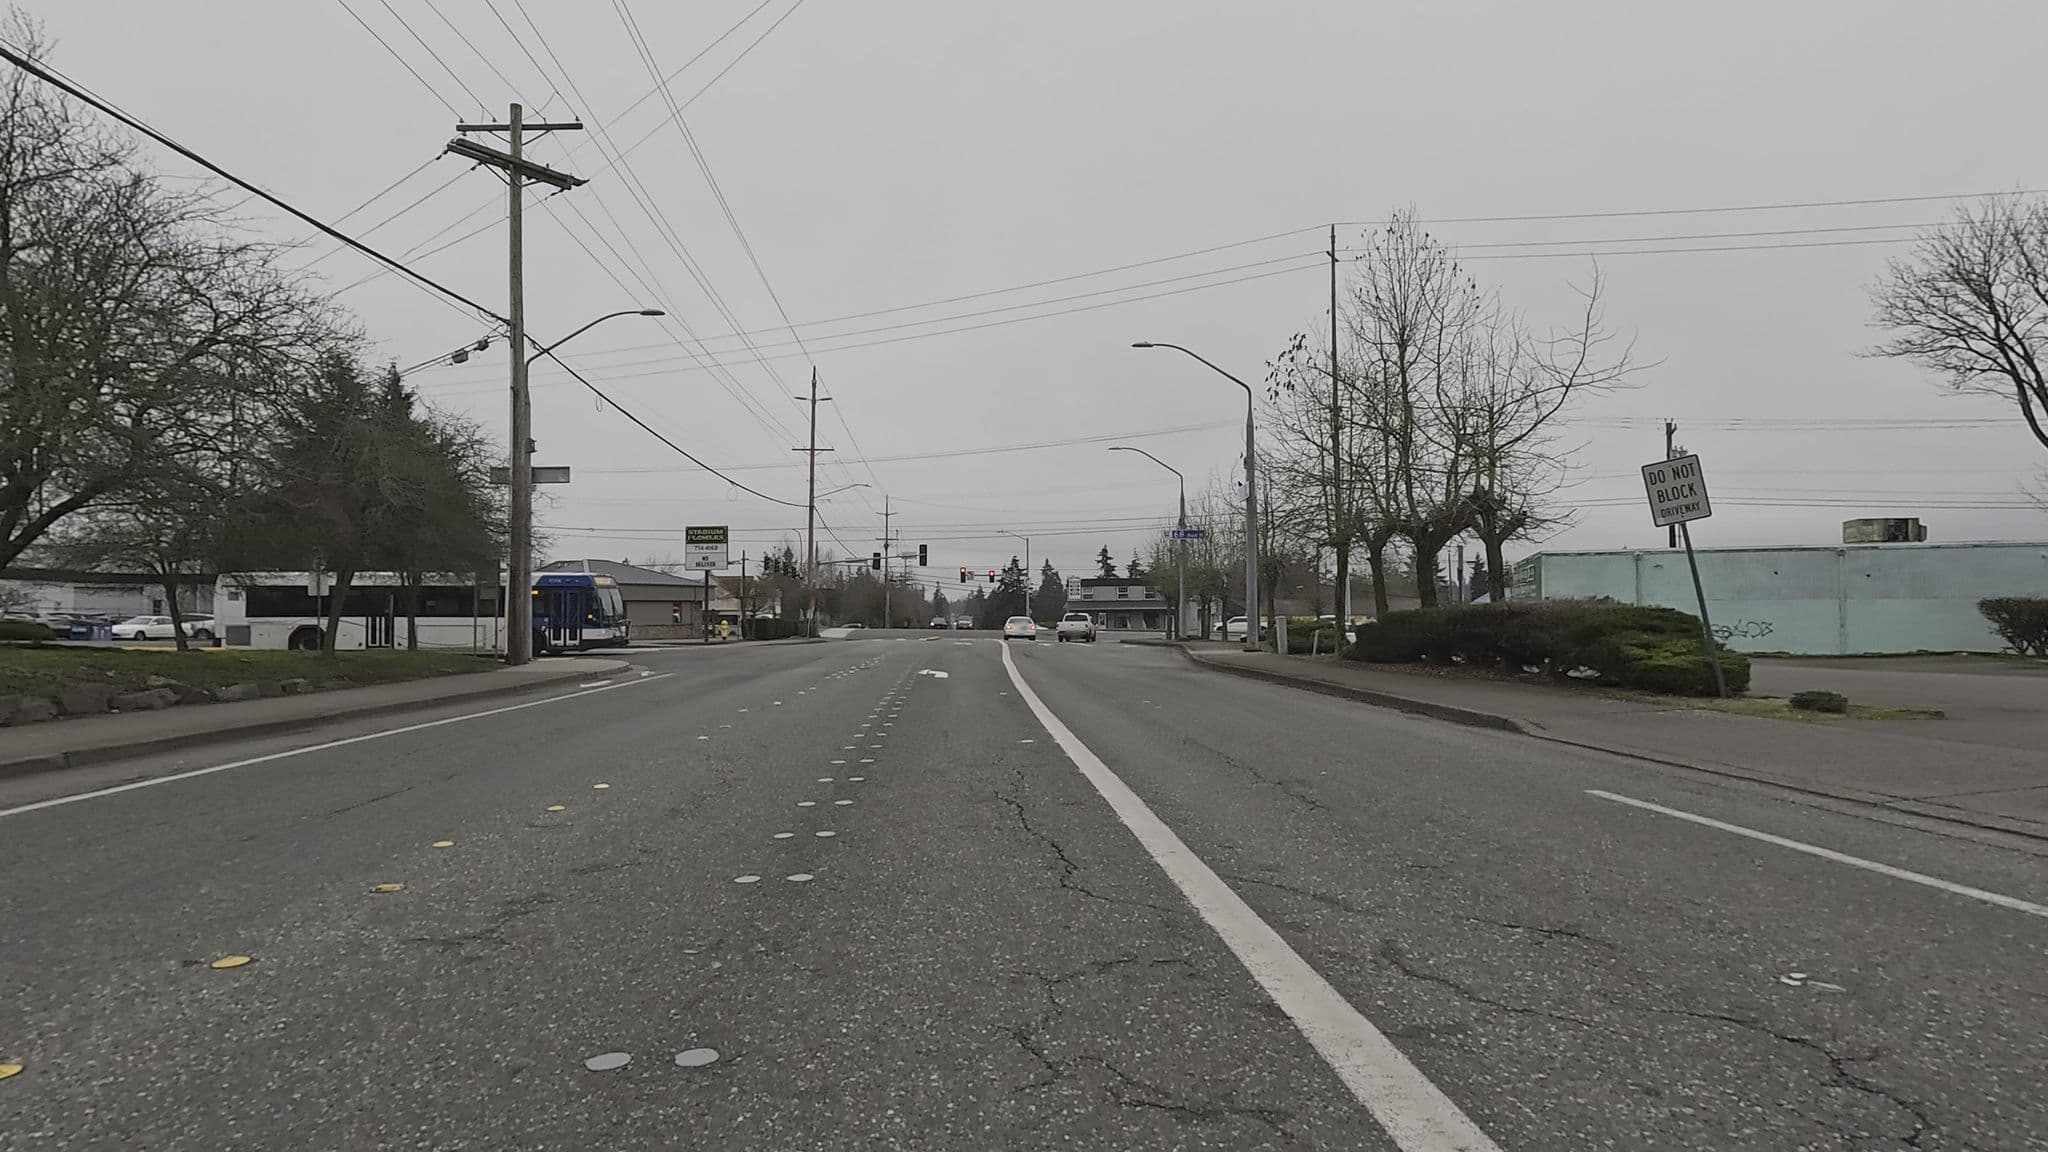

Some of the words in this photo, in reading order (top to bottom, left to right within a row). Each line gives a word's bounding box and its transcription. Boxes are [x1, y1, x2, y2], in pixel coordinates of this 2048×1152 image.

[1648, 469, 1666, 485] DO
[1671, 463, 1695, 480] NOT
[1657, 482, 1697, 503] BLOCK
[1661, 502, 1701, 518] DRIVEWAY
